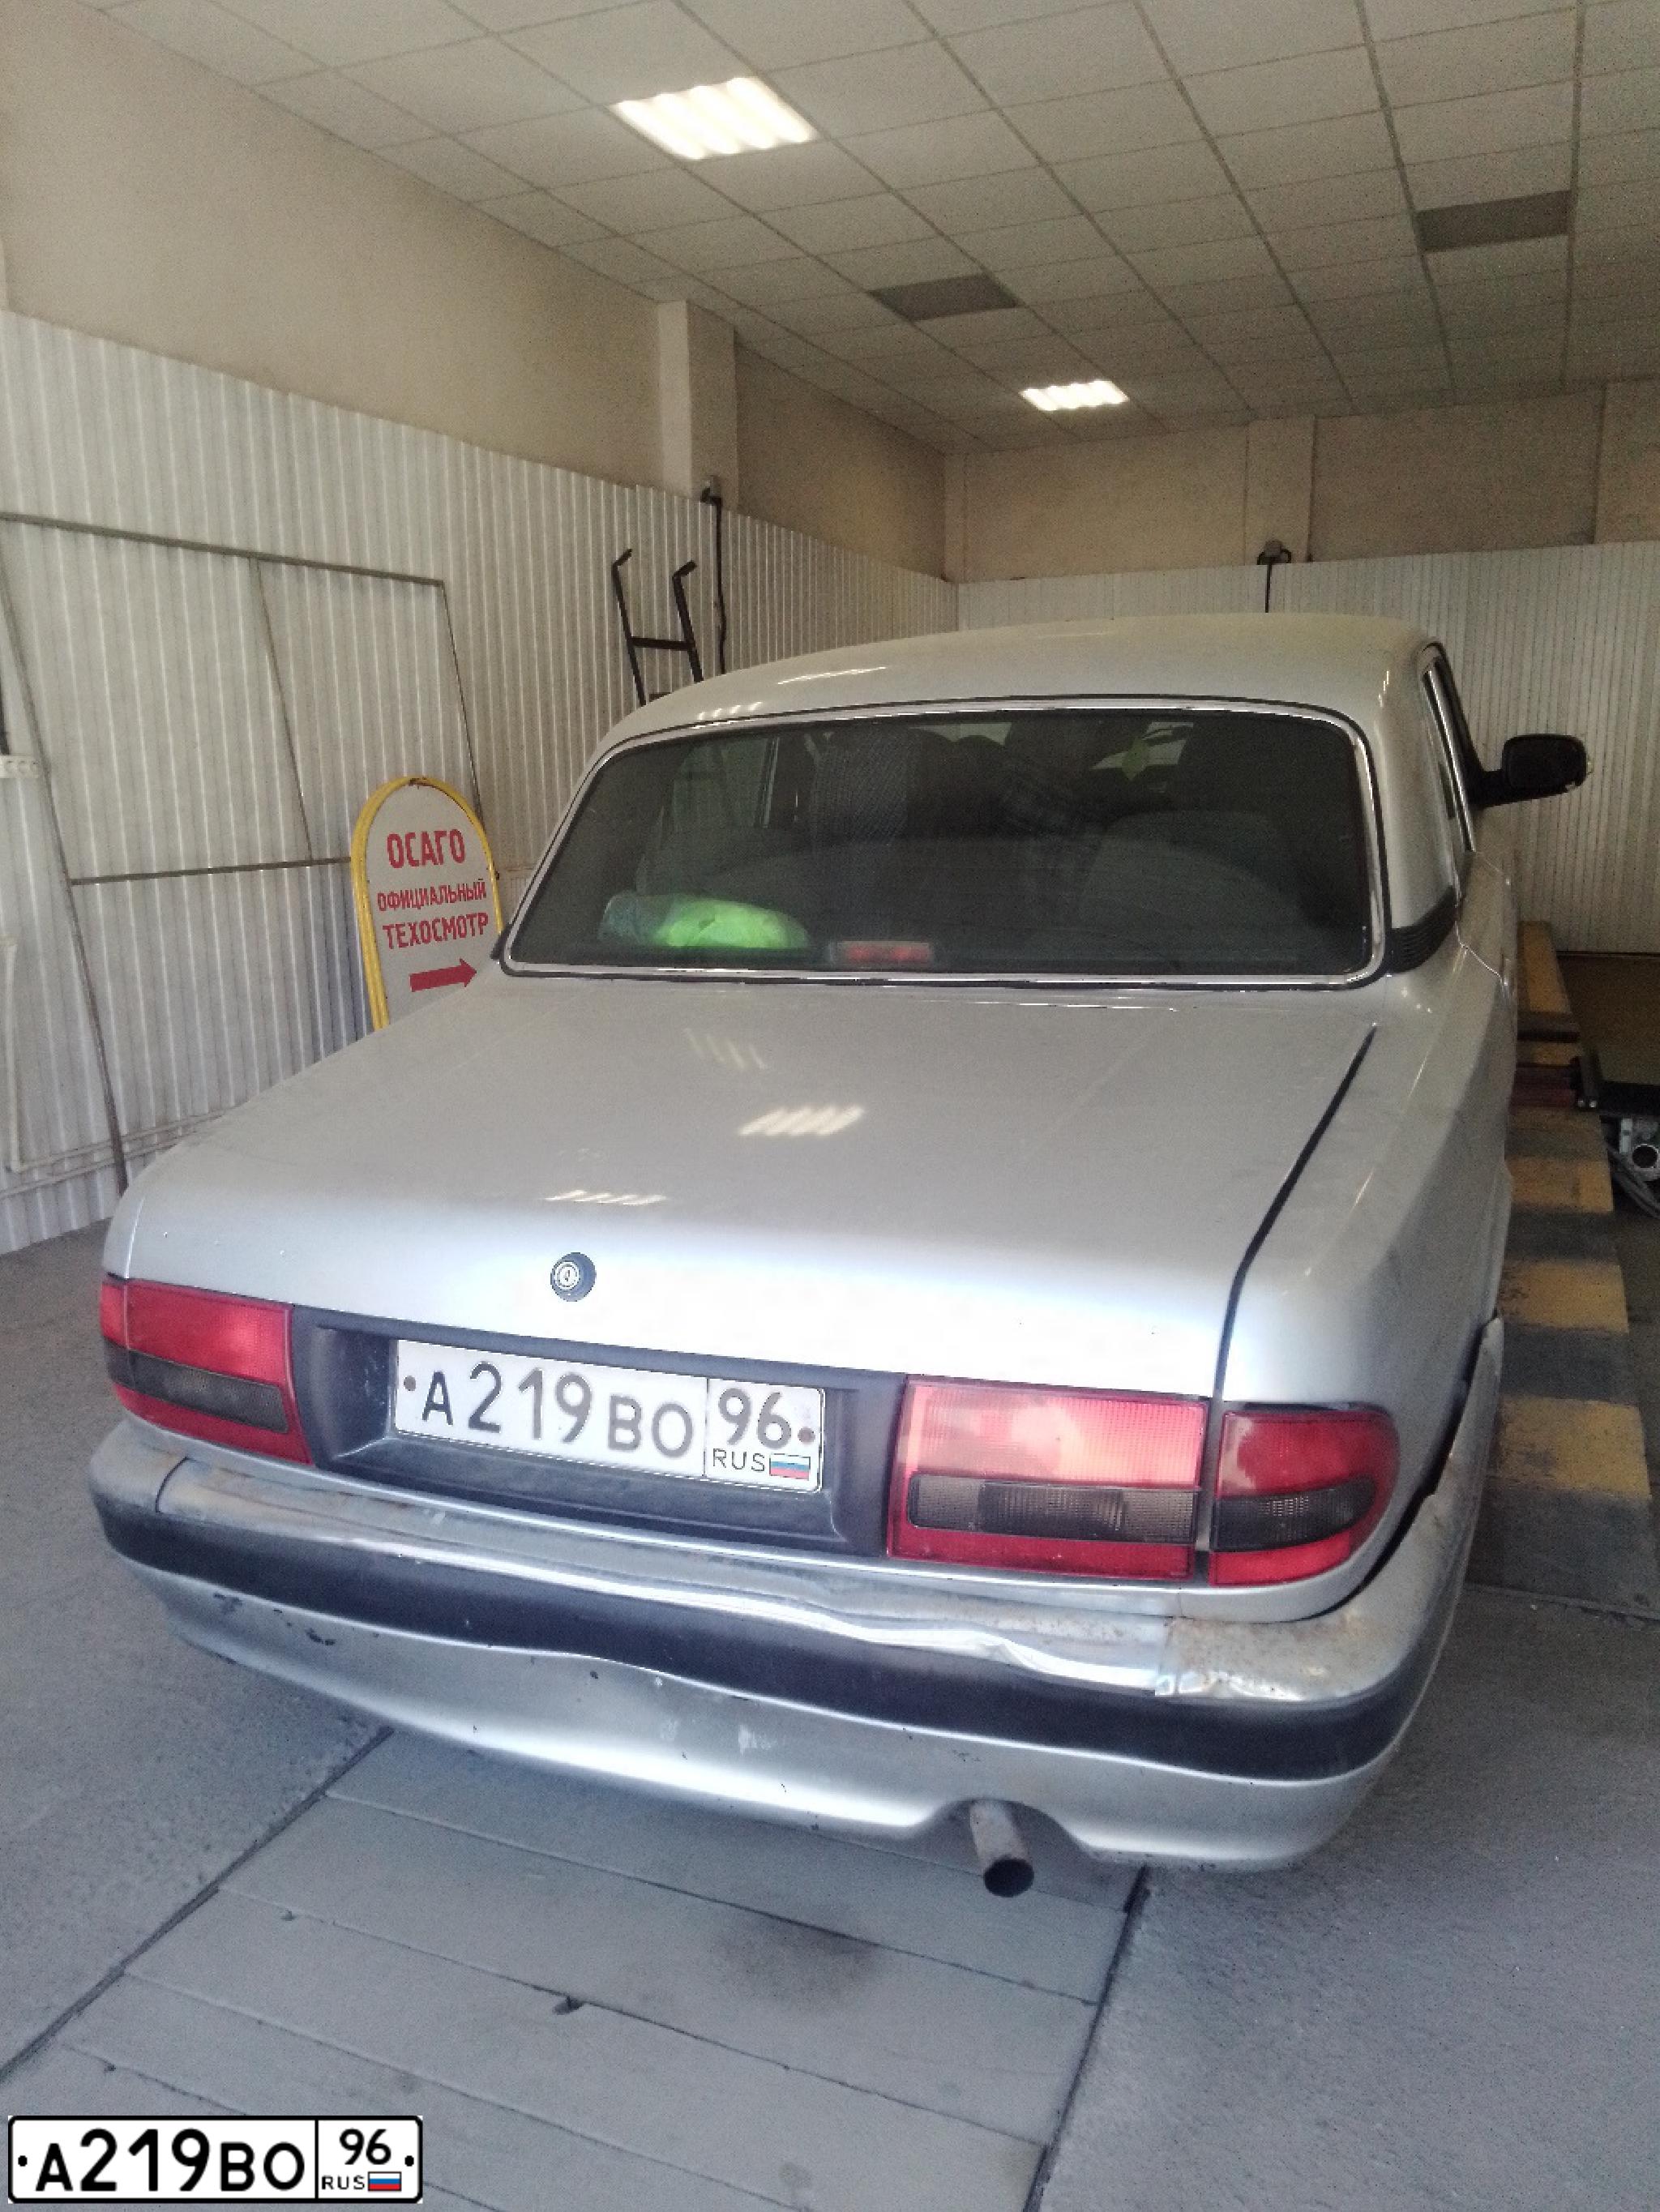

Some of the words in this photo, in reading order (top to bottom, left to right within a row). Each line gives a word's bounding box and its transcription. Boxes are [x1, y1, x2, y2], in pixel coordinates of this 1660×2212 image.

[387, 828, 466, 869] ОСАГО
[377, 878, 487, 912] ОФИЦИАЛЬНЫЙ
[382, 912, 489, 949] ТЕХОСМОТР
[717, 1388, 793, 1450] 96
[712, 1448, 766, 1473] RUS
